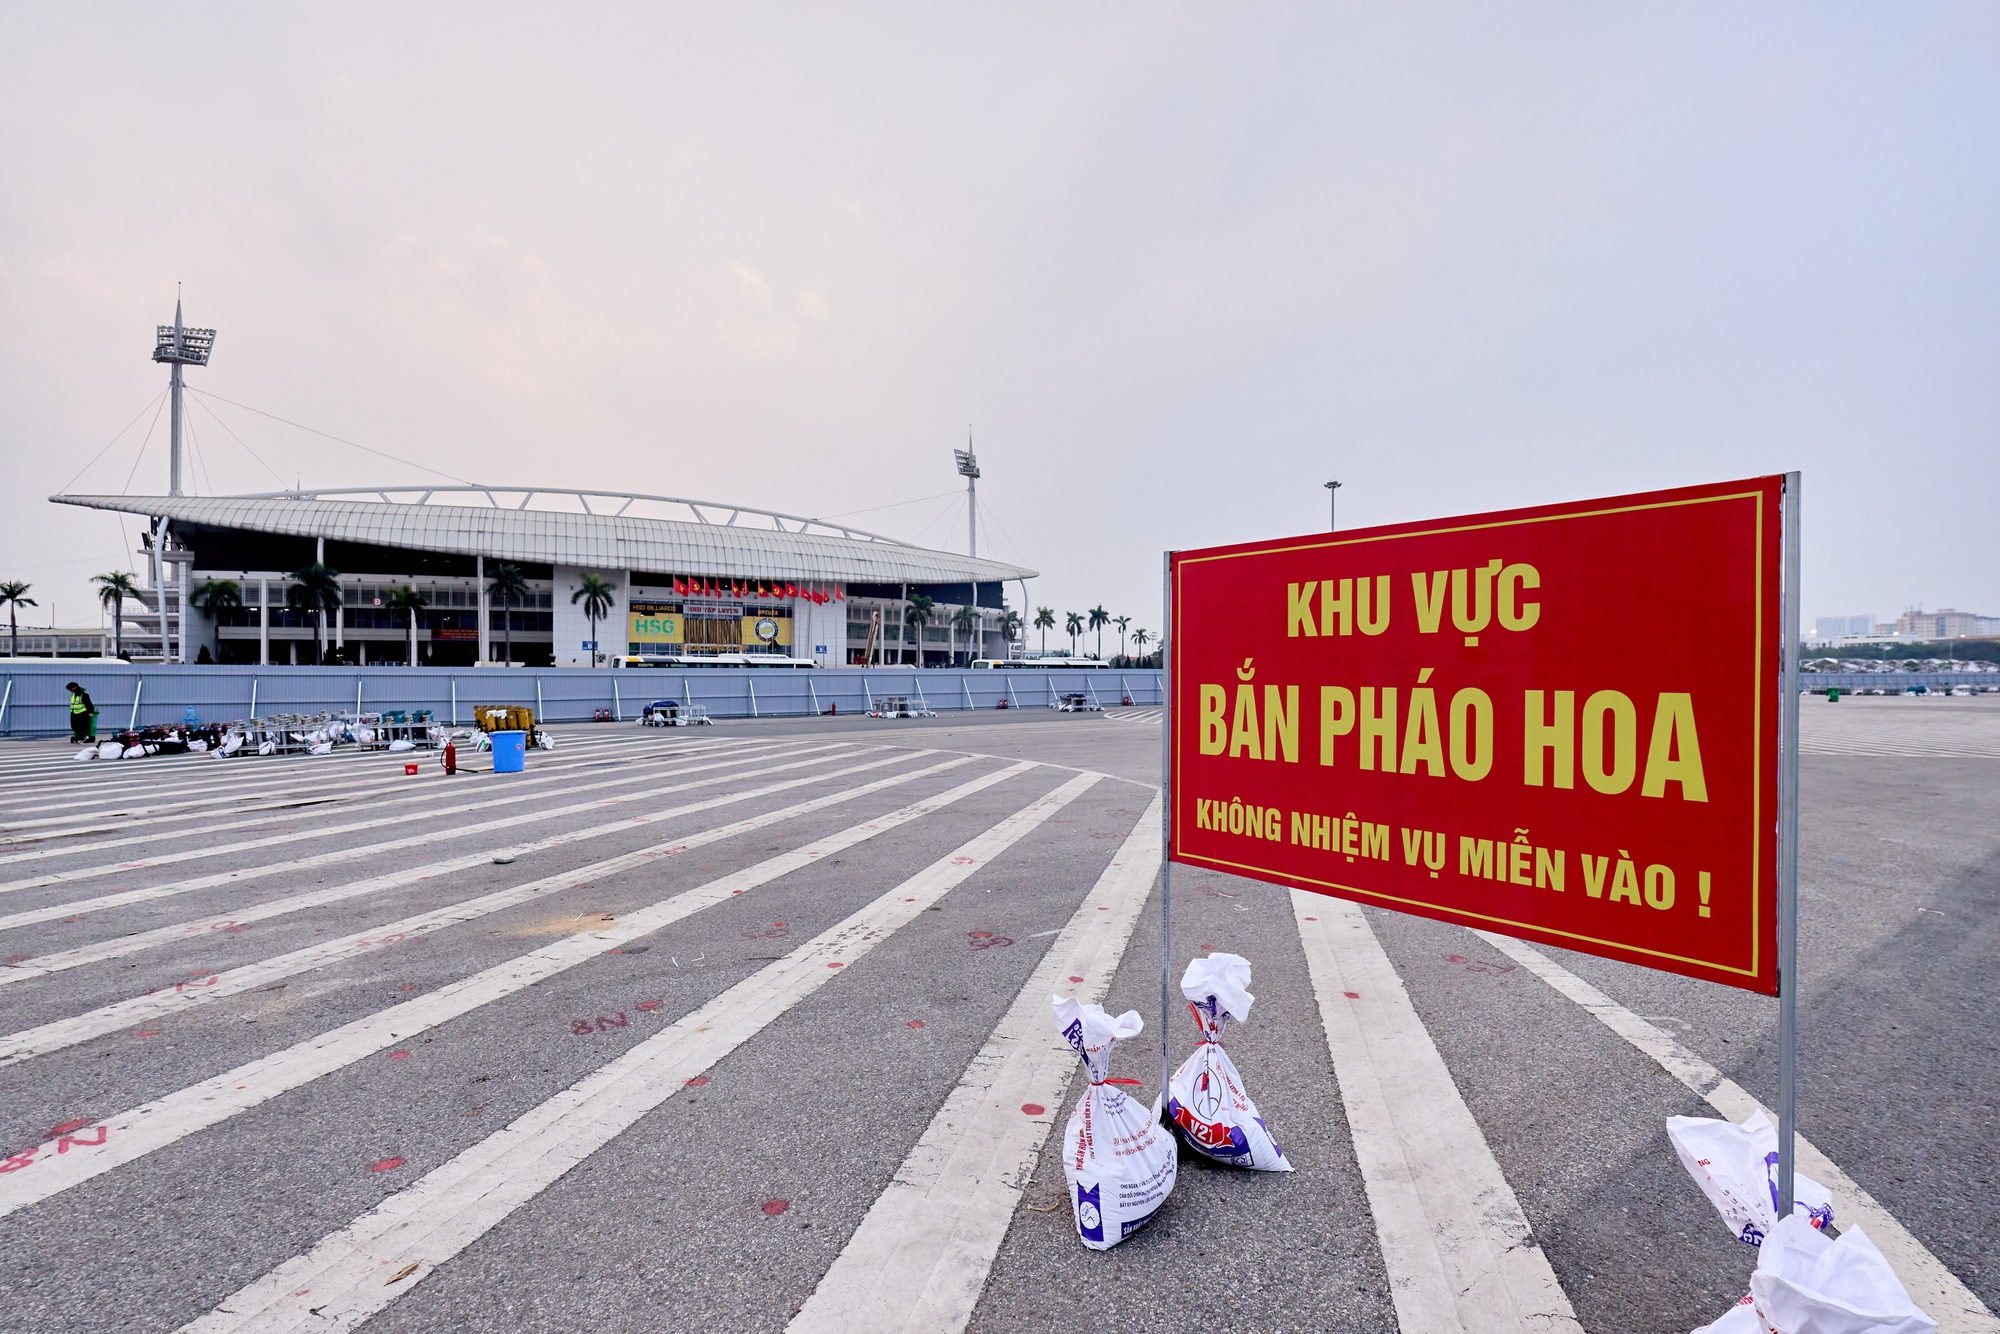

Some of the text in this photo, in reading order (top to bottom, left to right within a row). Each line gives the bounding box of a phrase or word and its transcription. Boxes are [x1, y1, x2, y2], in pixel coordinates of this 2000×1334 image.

[636, 618, 674, 634] HSG
[1287, 558, 1541, 647] KHU VỰC
[1199, 657, 1709, 803] BẮN PHÁO HOA
[1196, 796, 1711, 918] KHÔNG NHIỆM VỤ MIỄN VÀO !
